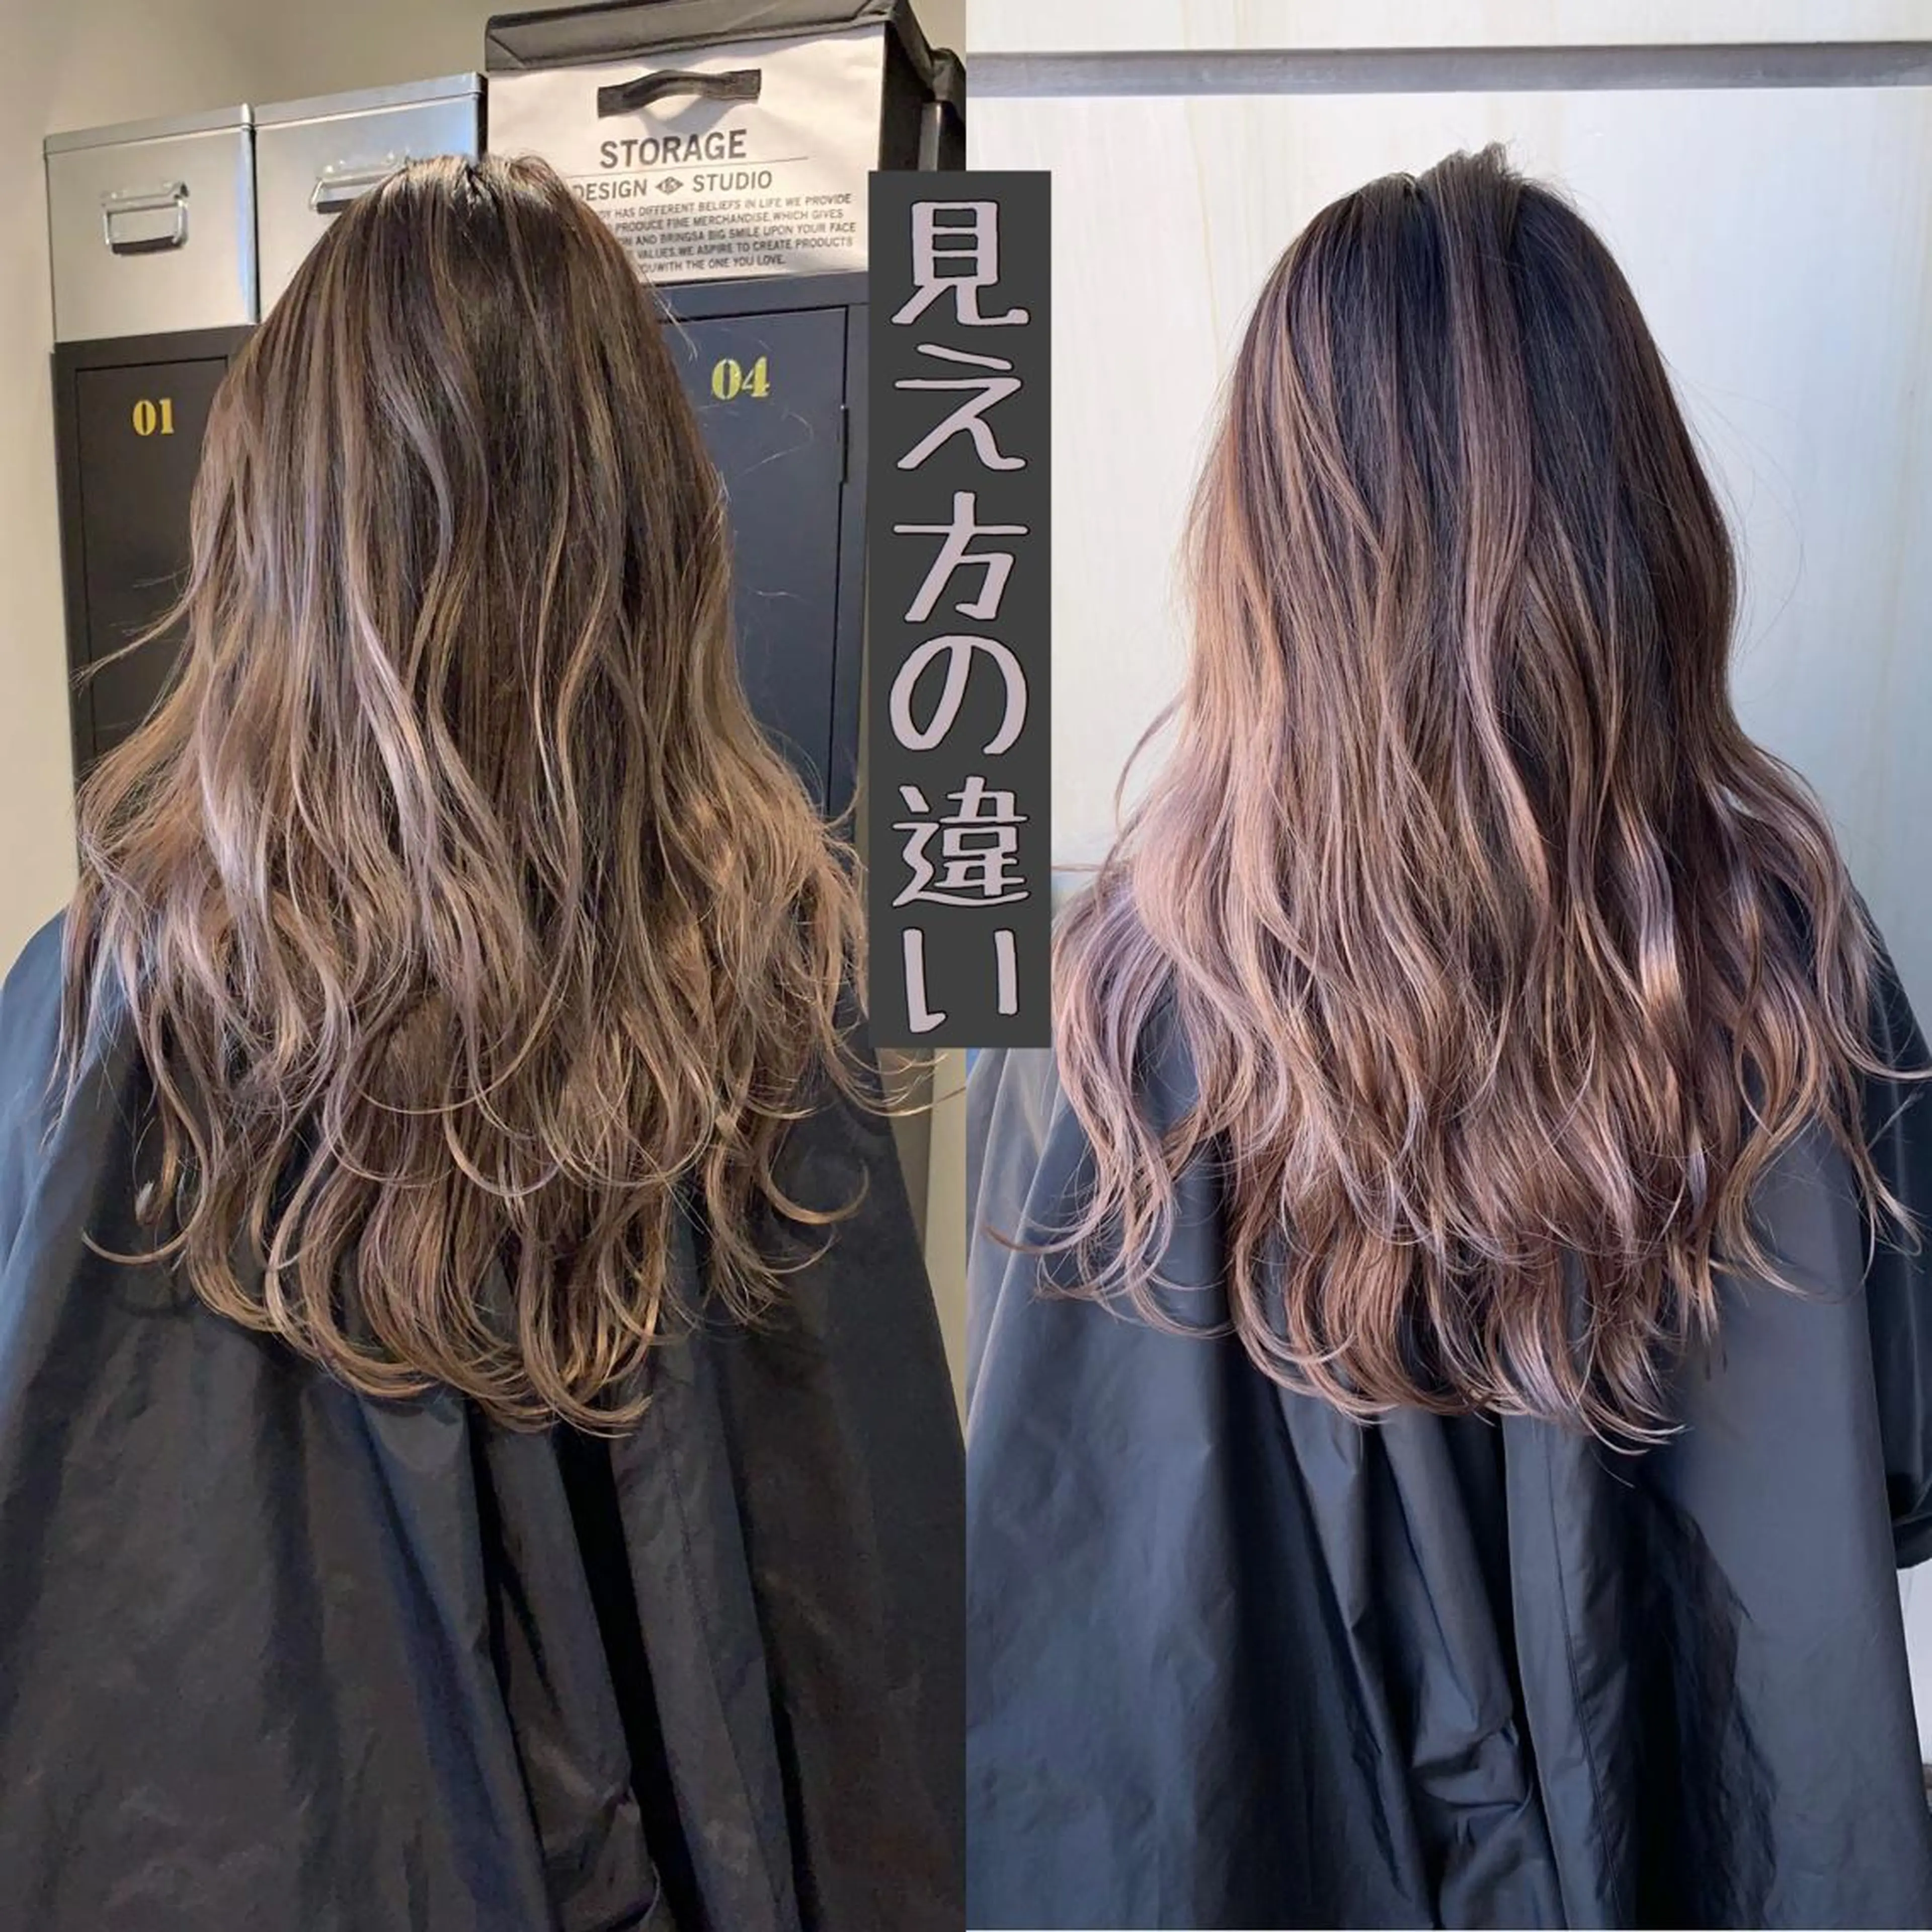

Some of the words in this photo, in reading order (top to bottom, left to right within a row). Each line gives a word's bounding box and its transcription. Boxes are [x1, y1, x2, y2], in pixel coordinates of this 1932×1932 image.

[600, 129, 747, 169] STORAGE
[573, 179, 648, 201] DESIGN
[692, 170, 773, 193] STUDIO
[615, 207, 635, 218] HAS
[638, 202, 695, 216] DIFFERENT
[698, 199, 741, 211] BELIEFS
[745, 199, 756, 209] IN
[759, 197, 782, 208] LIFE
[785, 196, 801, 207] WE
[805, 193, 852, 205] PROVIDE
[615, 219, 664, 232] PRODUCE
[667, 217, 690, 229] FINE
[812, 208, 844, 219] GIVES
[635, 233, 657, 246] AND
[708, 228, 726, 240] BIG
[729, 226, 760, 239] SMILE
[763, 224, 793, 236] UPON
[796, 222, 826, 233] YOUR
[830, 222, 856, 232] FACE
[697, 243, 732, 255] ASPIRE
[737, 242, 750, 253] TO
[753, 238, 792, 252] CREATE
[795, 236, 854, 250] PRODUCTS
[686, 259, 705, 270] THE
[708, 257, 731, 269] ONE
[734, 256, 754, 267] YOU
[711, 356, 771, 400] 04
[133, 398, 174, 436] 01
